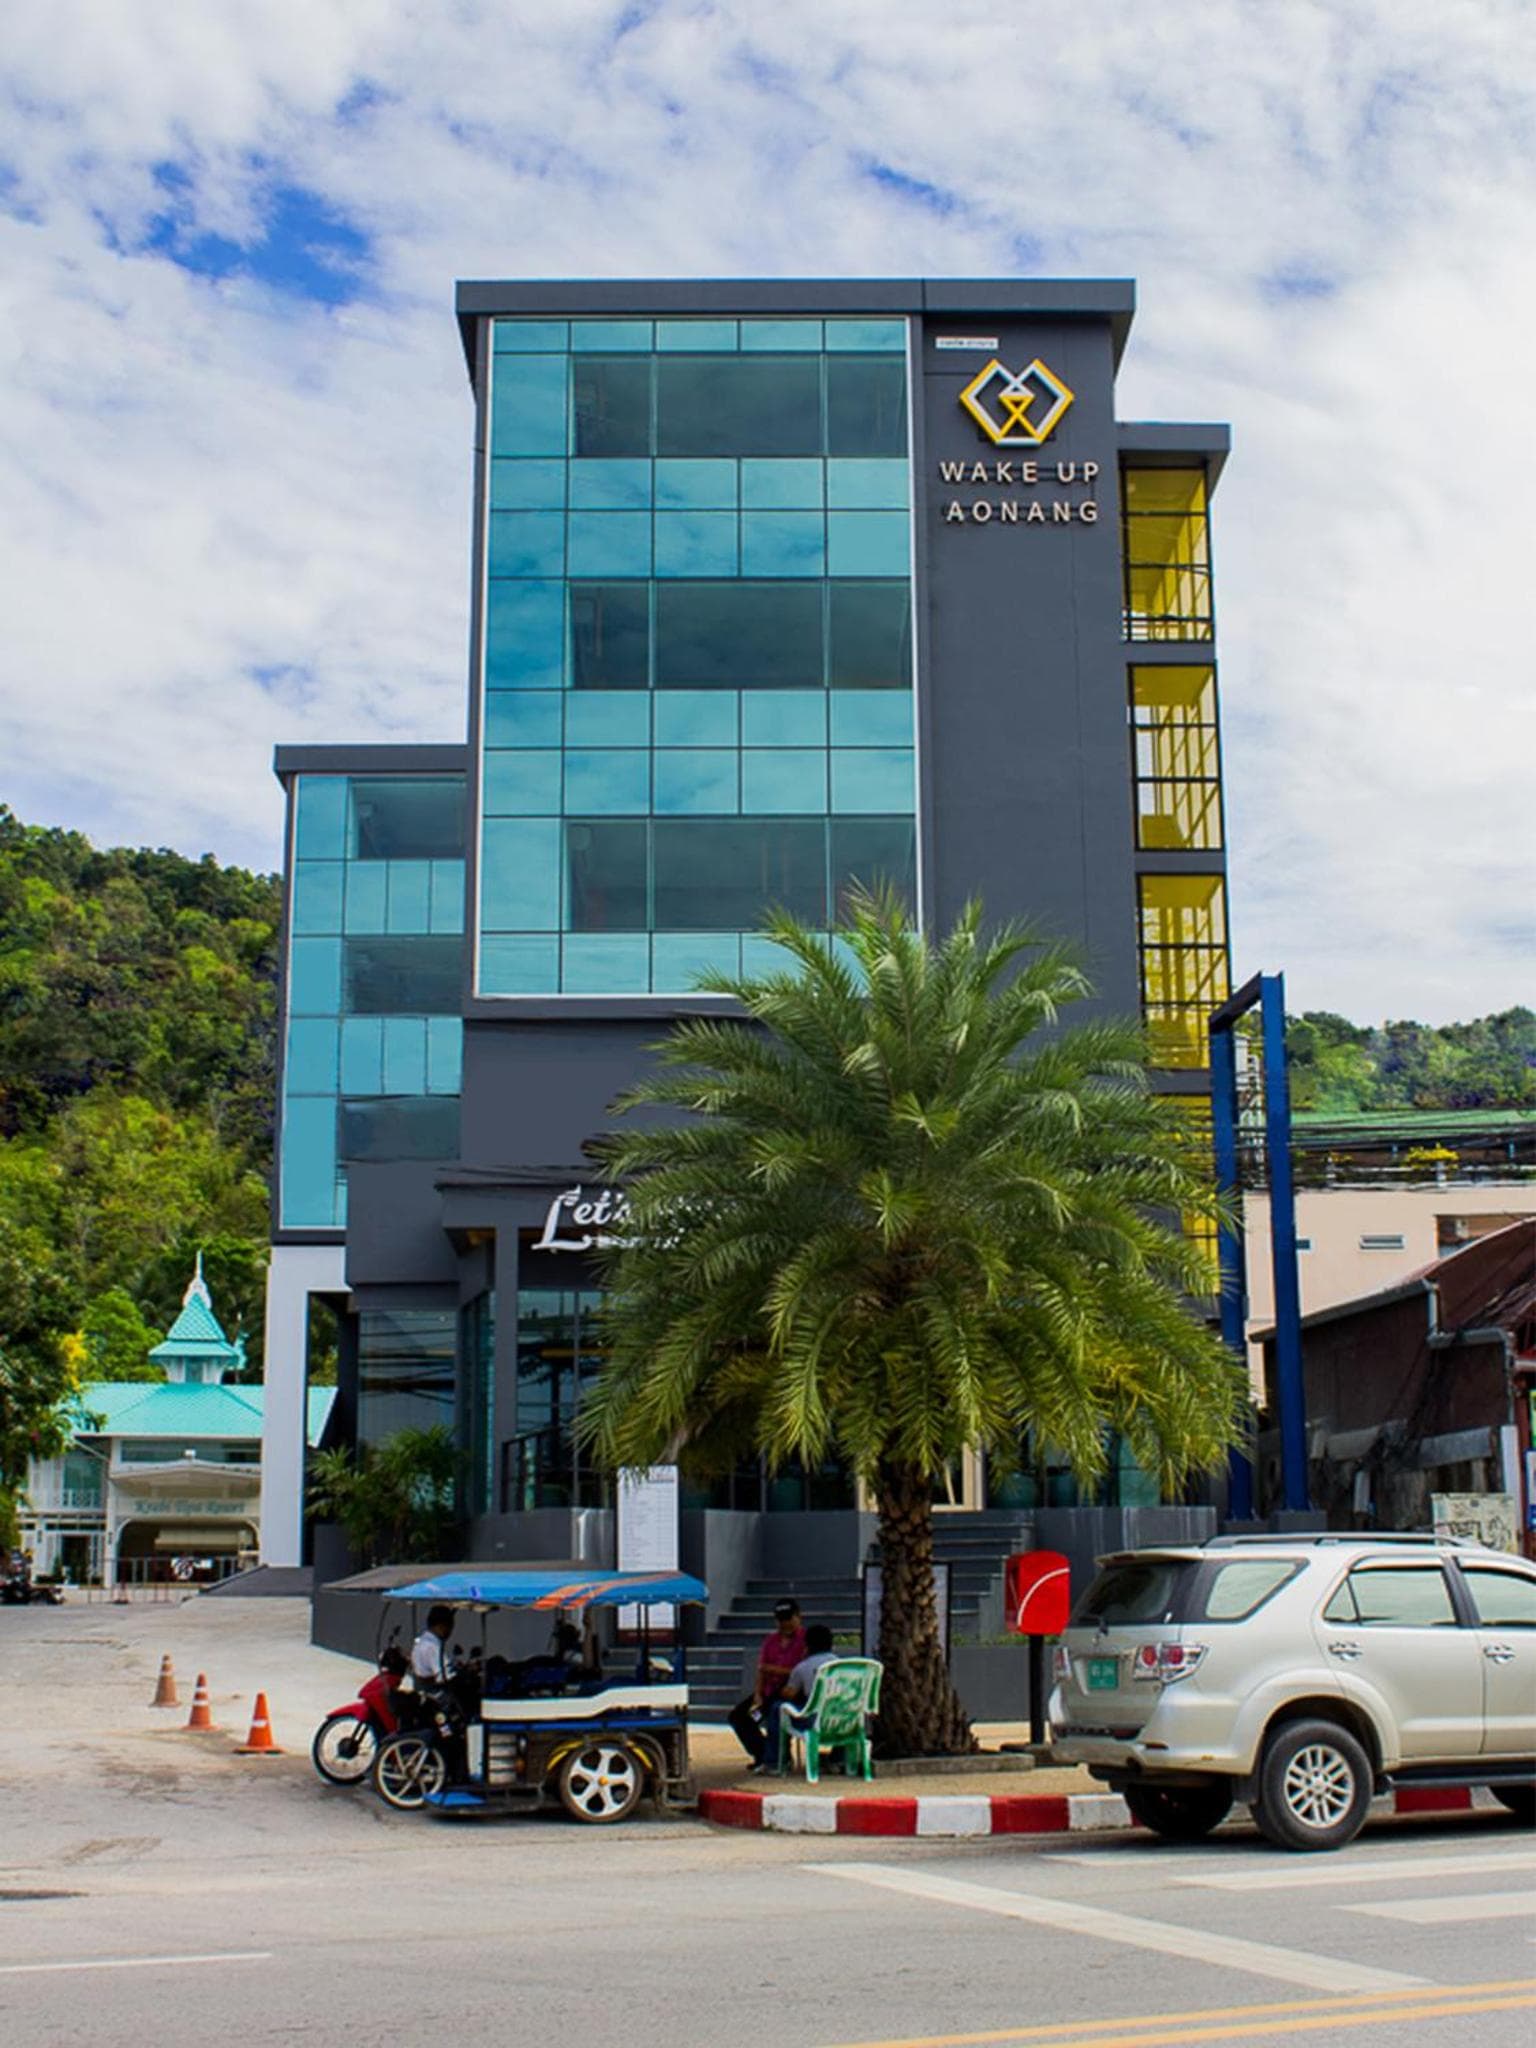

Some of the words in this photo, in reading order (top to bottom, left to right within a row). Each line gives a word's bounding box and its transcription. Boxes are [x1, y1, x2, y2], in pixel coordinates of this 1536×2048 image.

[940, 461, 1038, 483] WAKE
[1057, 461, 1099, 483] UP
[946, 501, 1098, 522] AONANG
